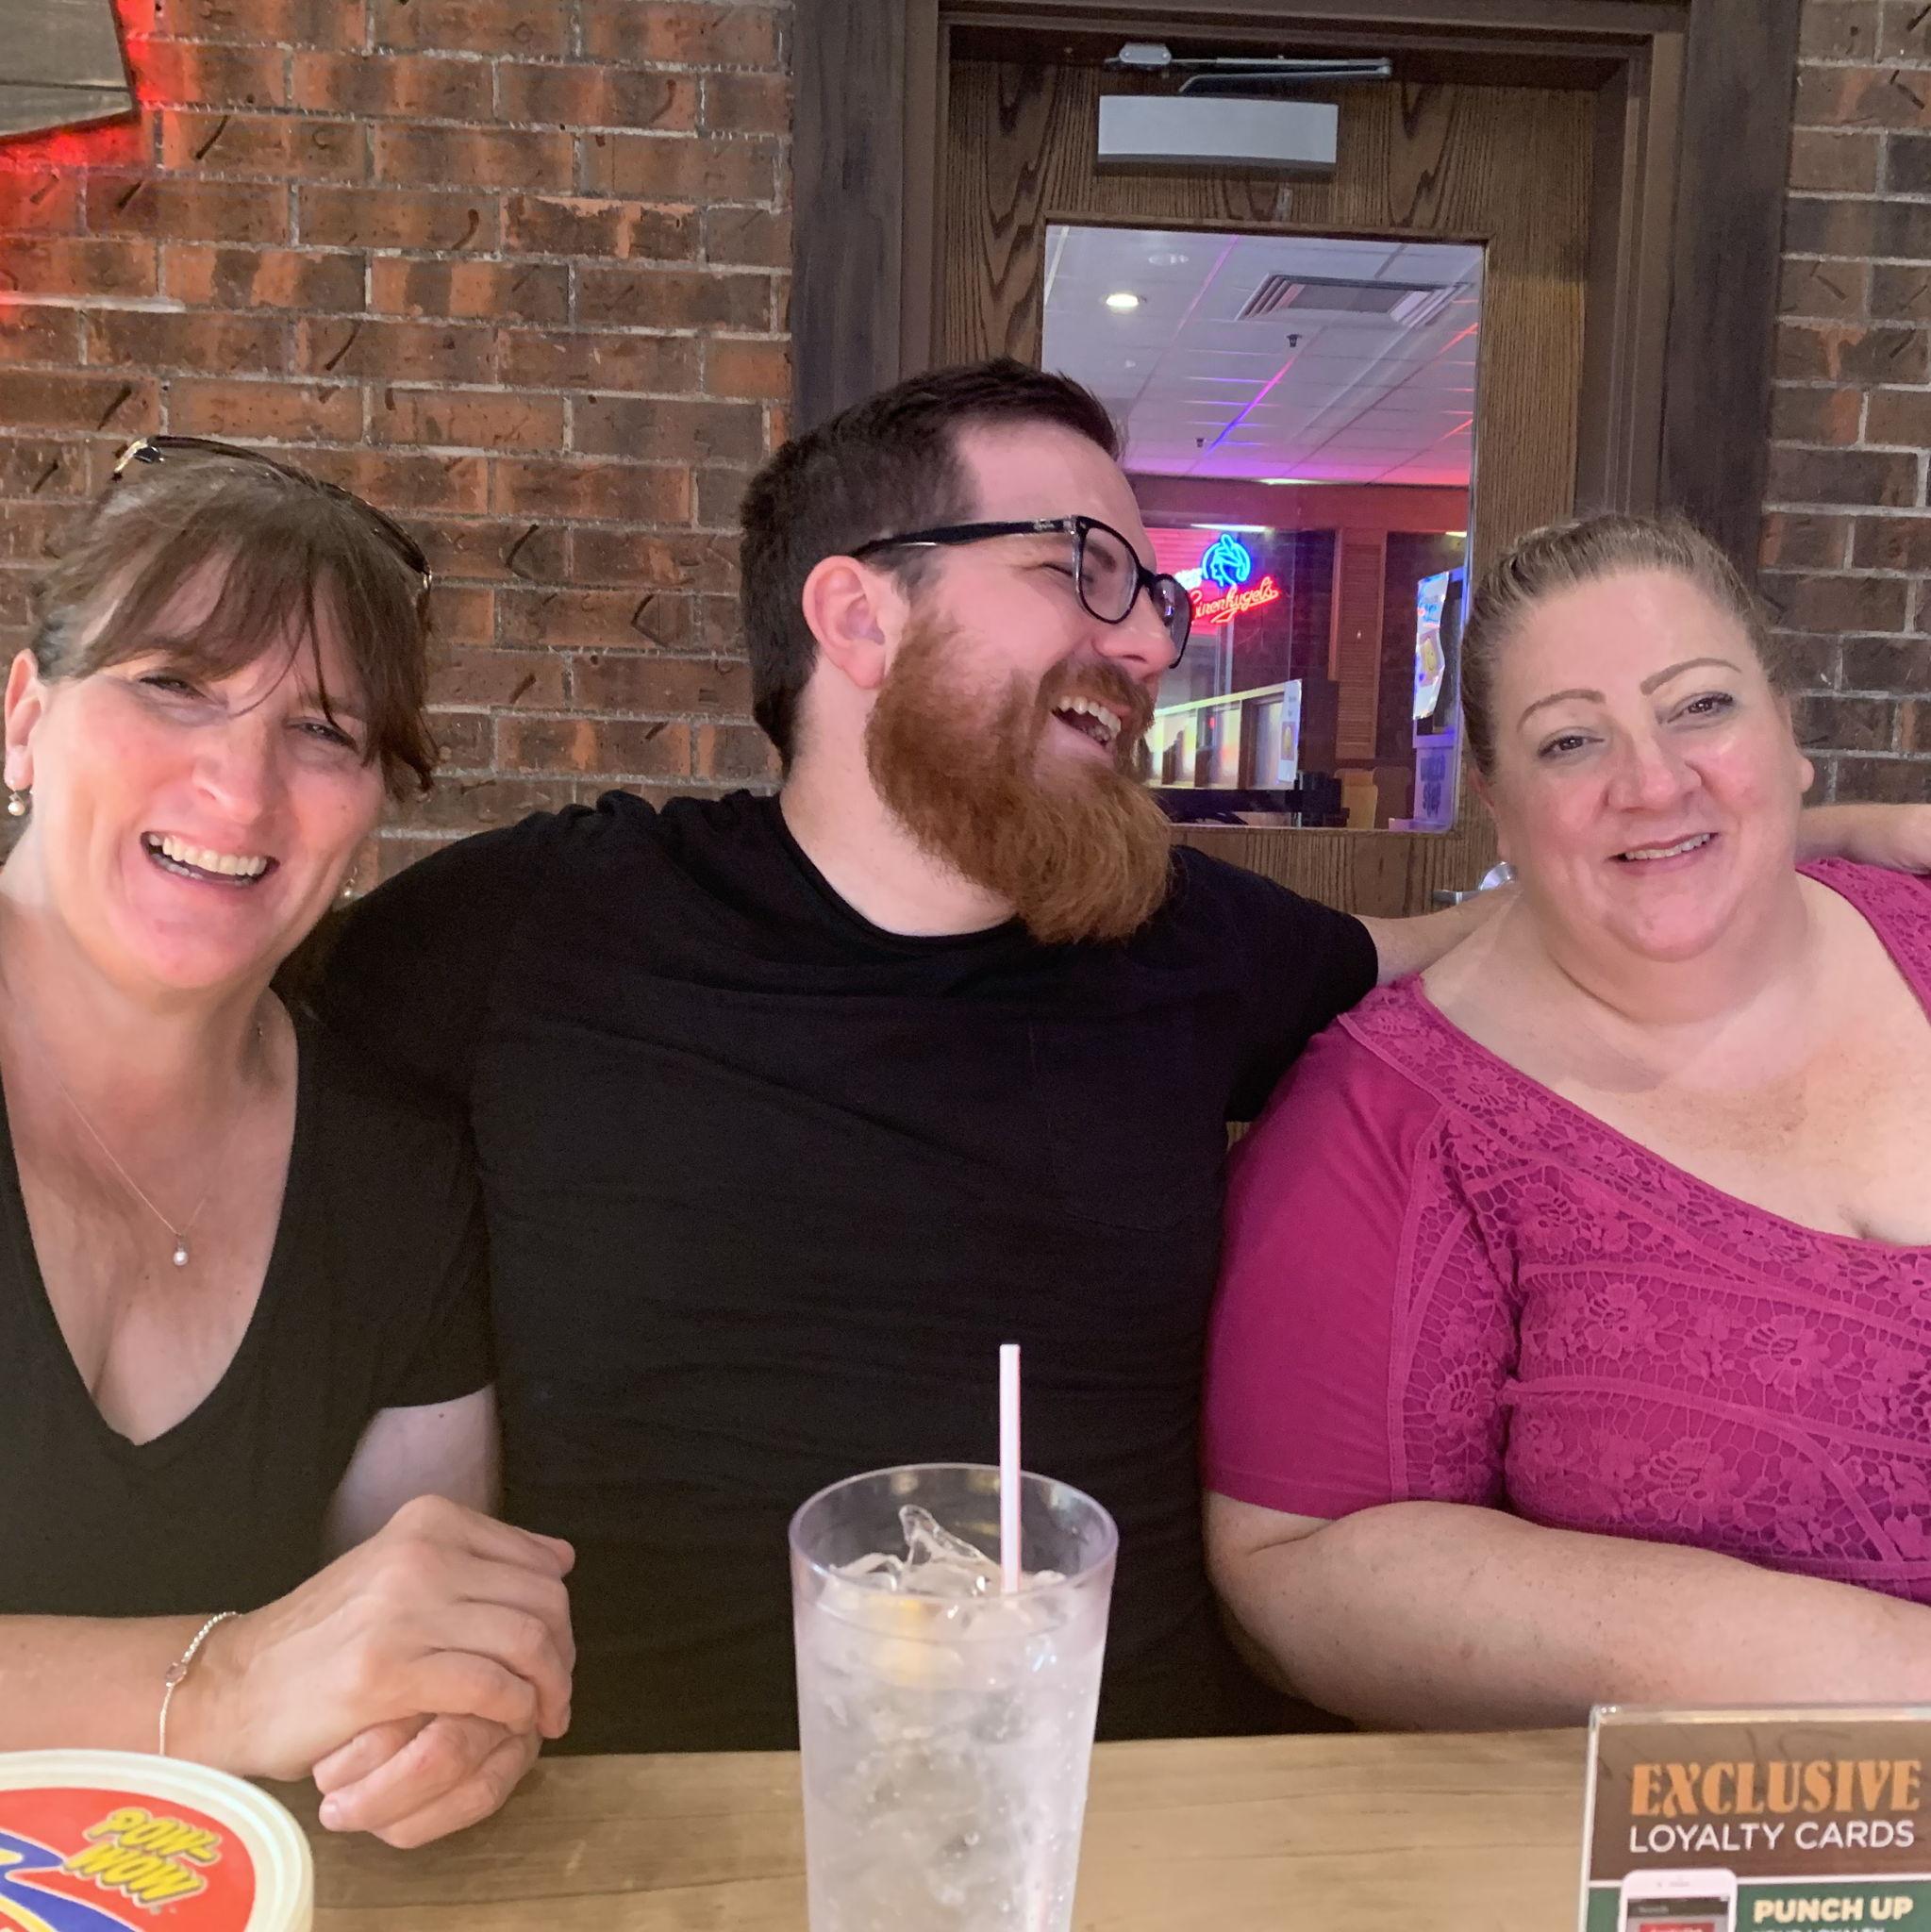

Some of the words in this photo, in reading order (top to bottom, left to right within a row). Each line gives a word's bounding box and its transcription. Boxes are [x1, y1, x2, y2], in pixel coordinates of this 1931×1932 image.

[1631, 1759, 1922, 1819] EXCLUSIVE
[1629, 1822, 1786, 1854] LOYALTY
[1794, 1820, 1915, 1850] CARDS
[63, 1842, 205, 1904] WOW
[1753, 1898, 1864, 1924] PUNCH
[1870, 1896, 1914, 1921] UP
